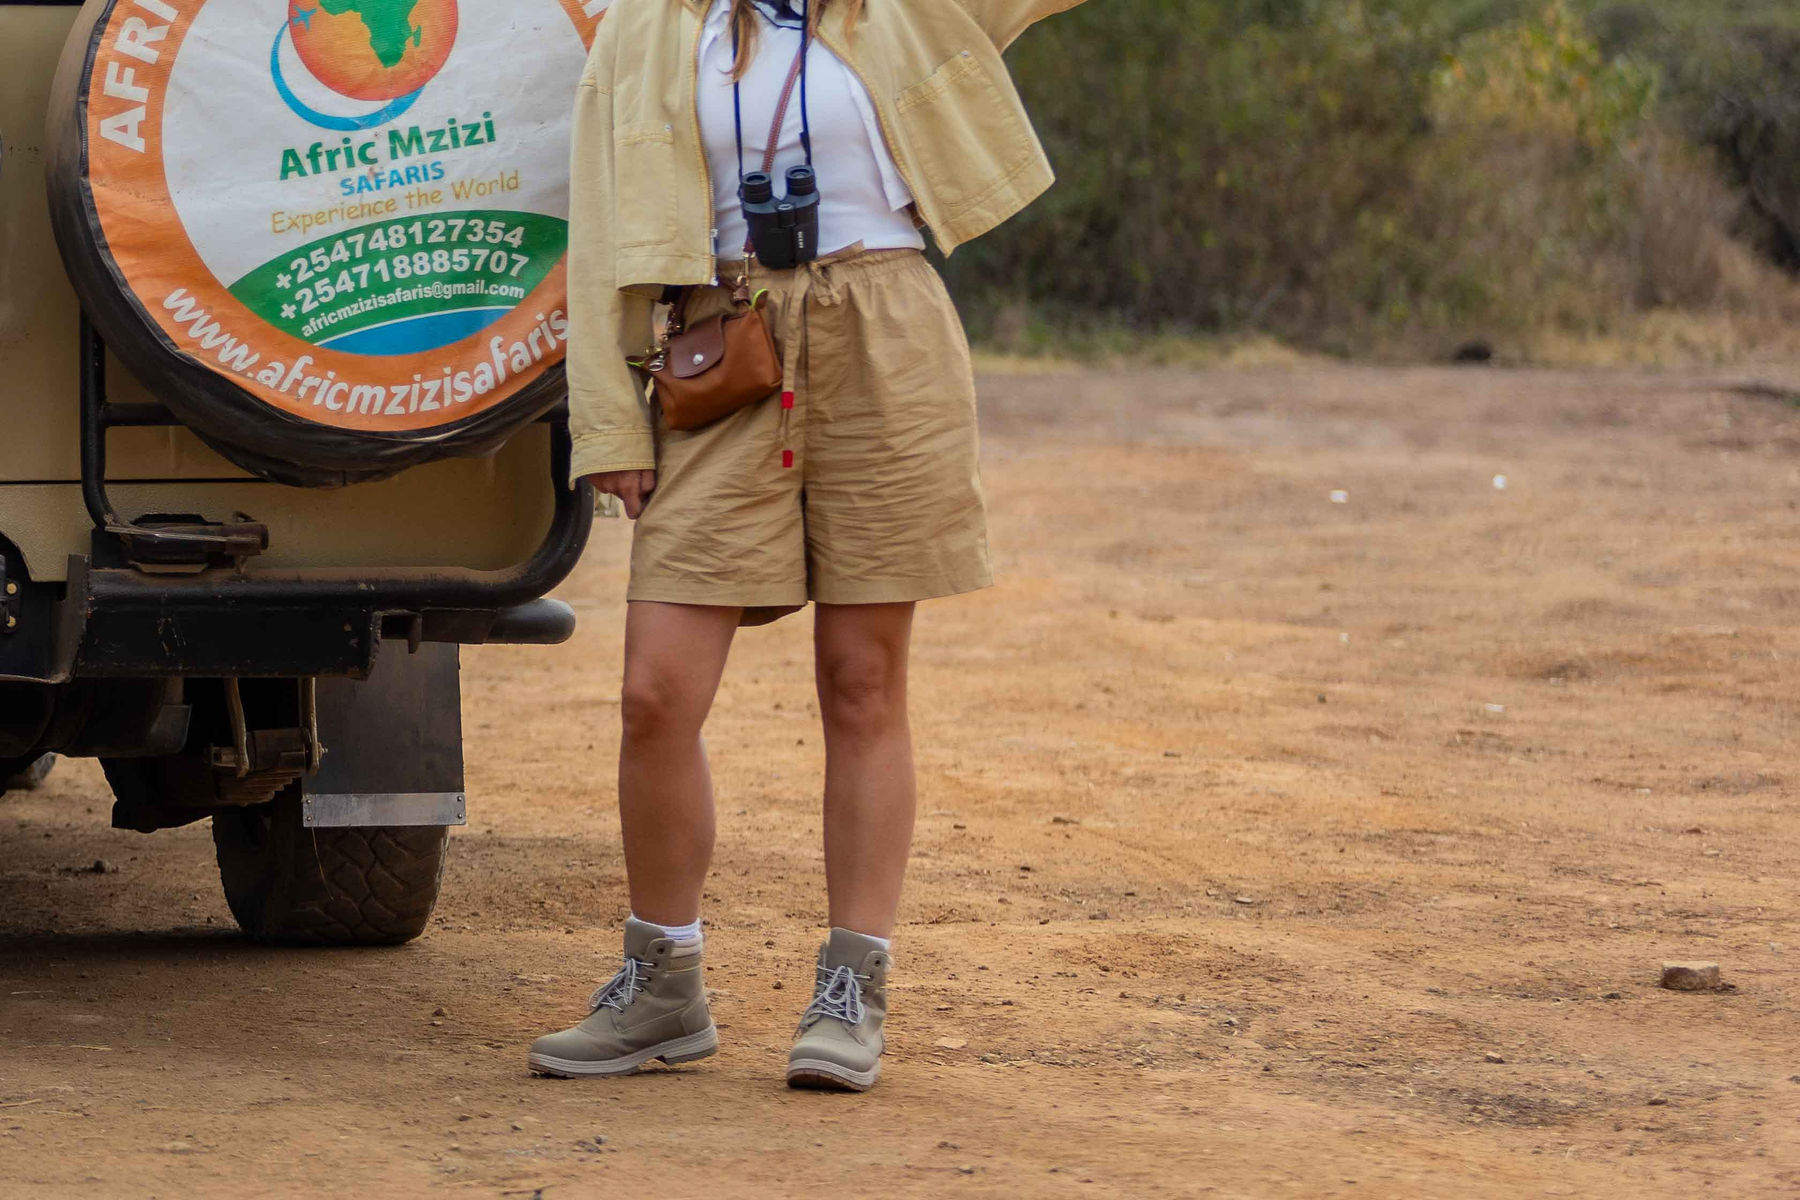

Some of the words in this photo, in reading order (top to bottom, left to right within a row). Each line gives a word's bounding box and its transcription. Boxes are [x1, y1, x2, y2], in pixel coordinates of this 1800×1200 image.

[279, 137, 378, 181] Afric
[387, 111, 497, 161] Mzizi
[339, 161, 446, 197] SAFARIS
[270, 196, 398, 235] Experience
[404, 187, 443, 209] the
[450, 169, 520, 200] World
[275, 218, 526, 290] +254748127354
[279, 248, 530, 320] +254718885707
[301, 279, 525, 338] africmzizisafaris@gmail.com
[162, 287, 569, 416] www.africmzizisafaris
